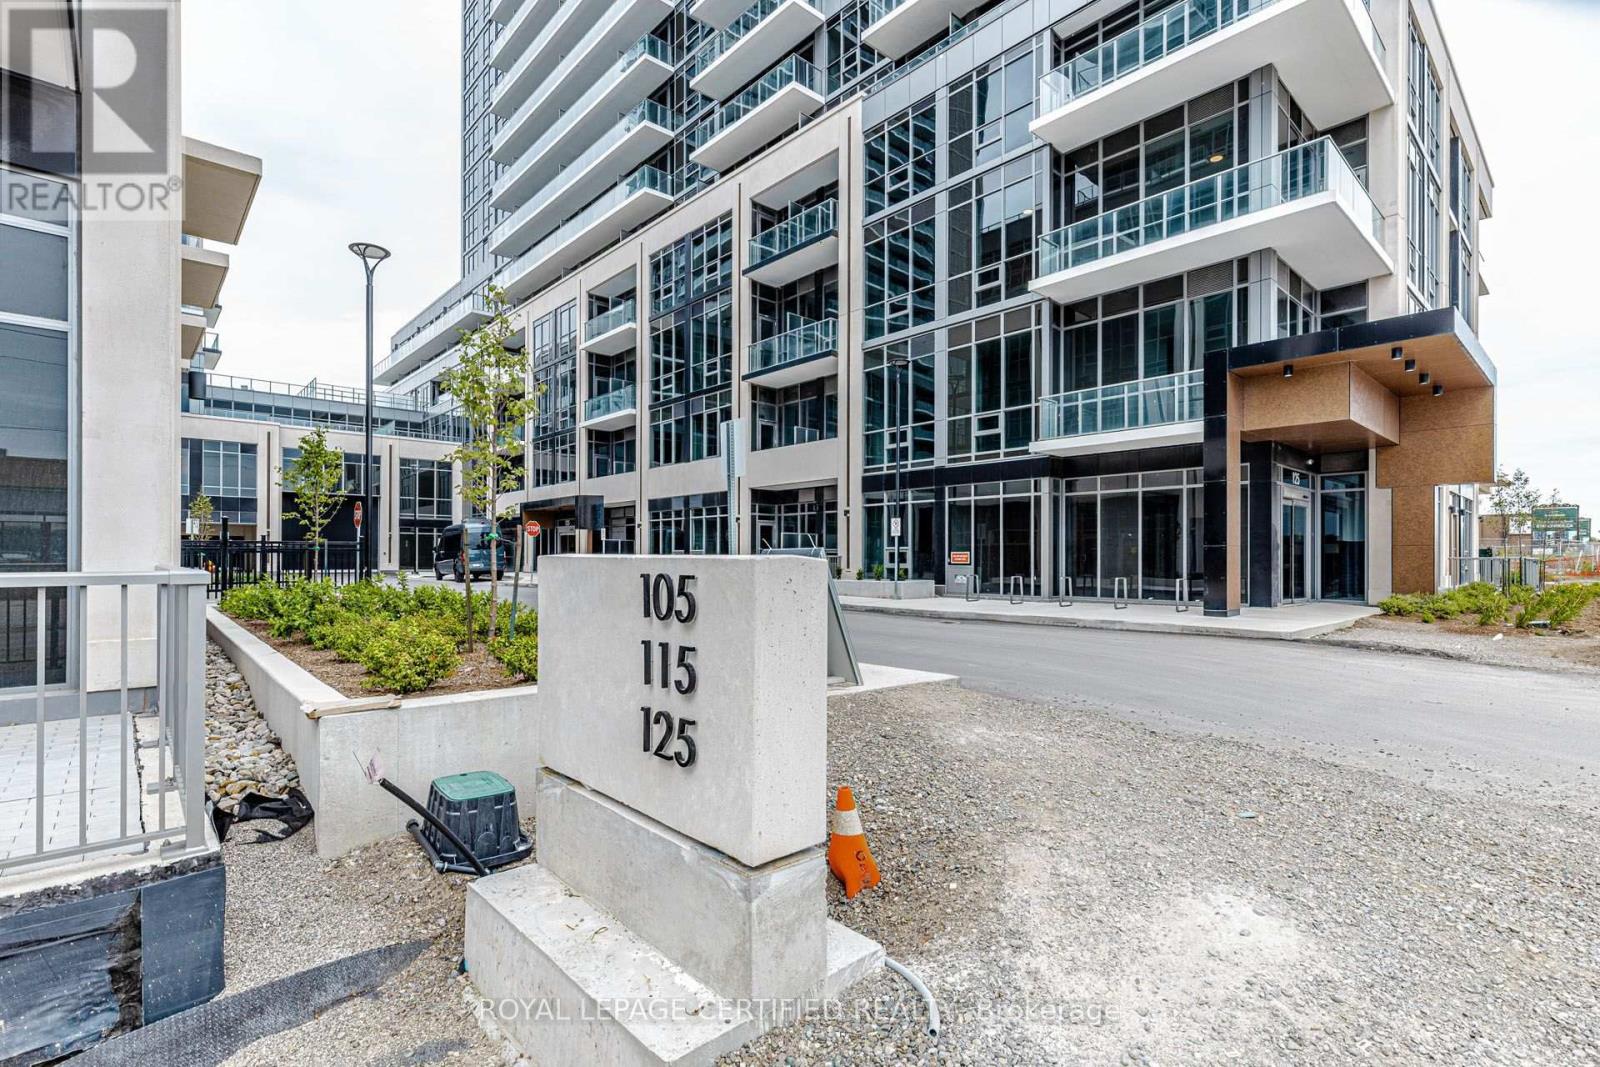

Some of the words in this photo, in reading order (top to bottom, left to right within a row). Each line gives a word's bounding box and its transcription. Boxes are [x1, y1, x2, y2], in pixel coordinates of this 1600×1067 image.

[640, 573, 696, 623] 105
[641, 640, 696, 695] 115
[640, 707, 696, 768] 125
